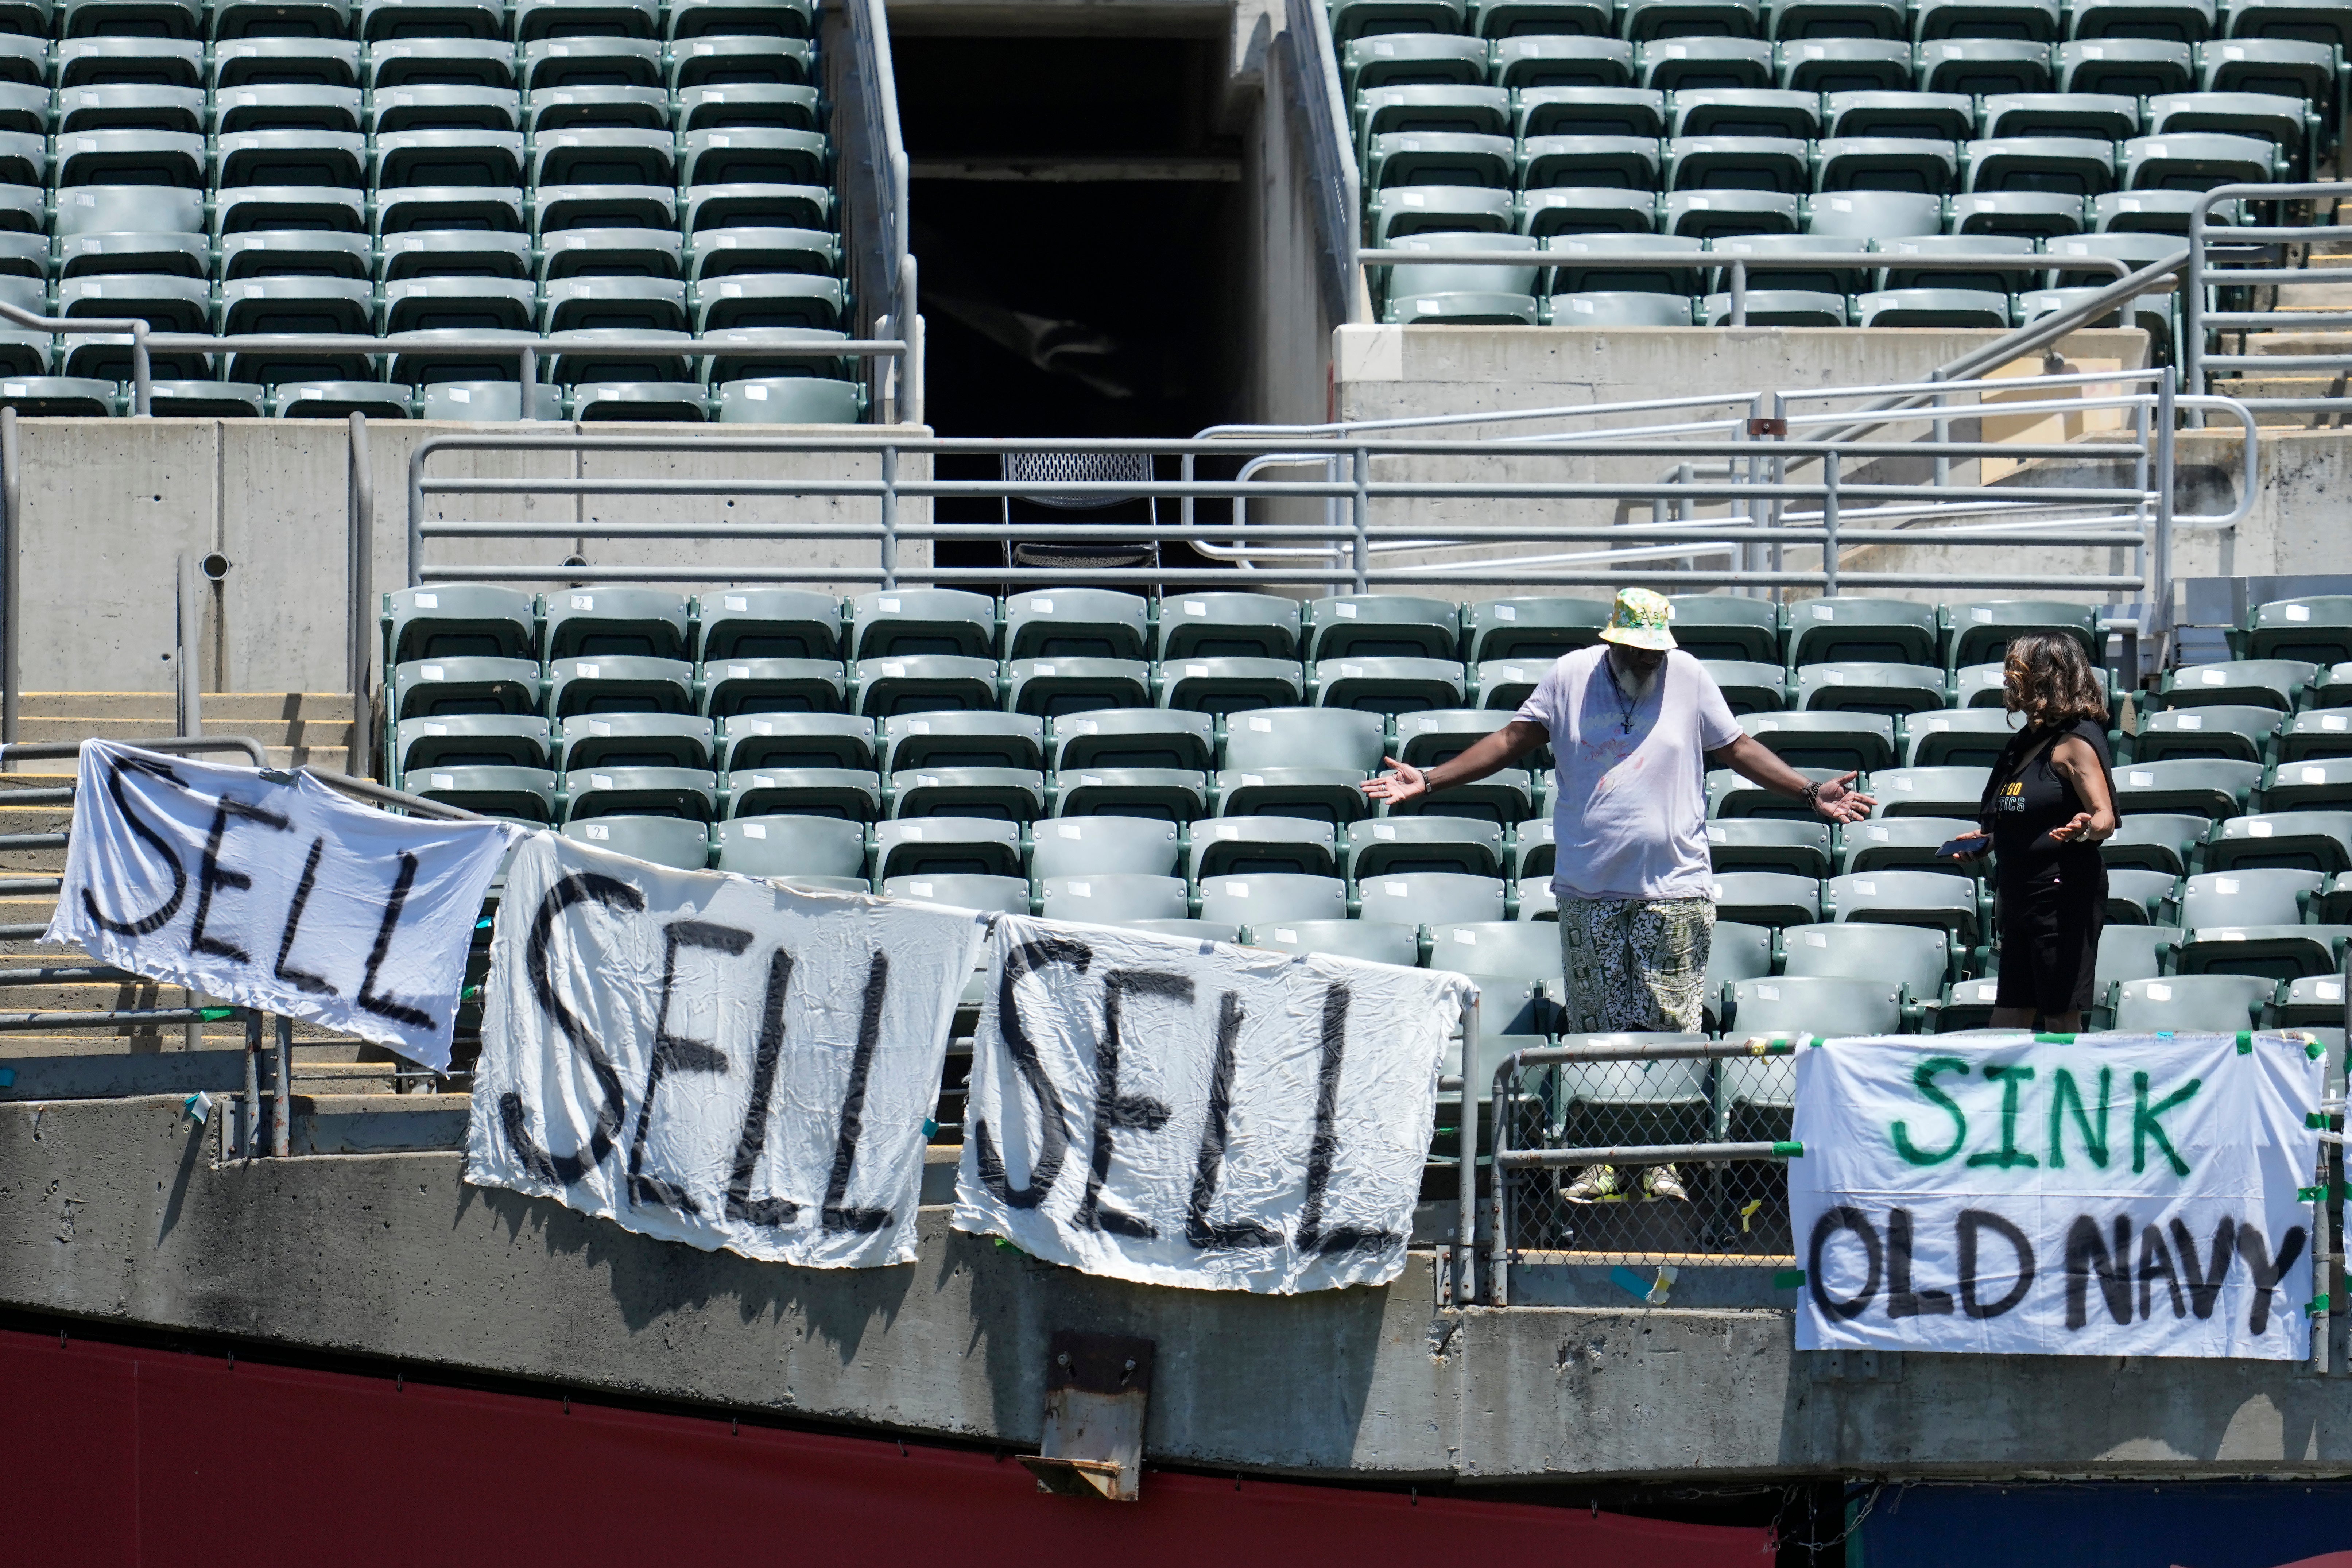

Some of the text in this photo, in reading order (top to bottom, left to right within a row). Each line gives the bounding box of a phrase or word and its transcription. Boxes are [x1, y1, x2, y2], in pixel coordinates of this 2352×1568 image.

[579, 597, 584, 608] 2
[1818, 607, 1828, 619] 10
[584, 666, 590, 676] 2
[594, 826, 600, 838] 2
[82, 757, 437, 1030] SELL
[499, 873, 894, 1234] SELL
[976, 939, 1407, 1252] SELL
[1892, 1057, 2201, 1177] SINK
[1809, 1206, 2310, 1335] OLD NAVY
